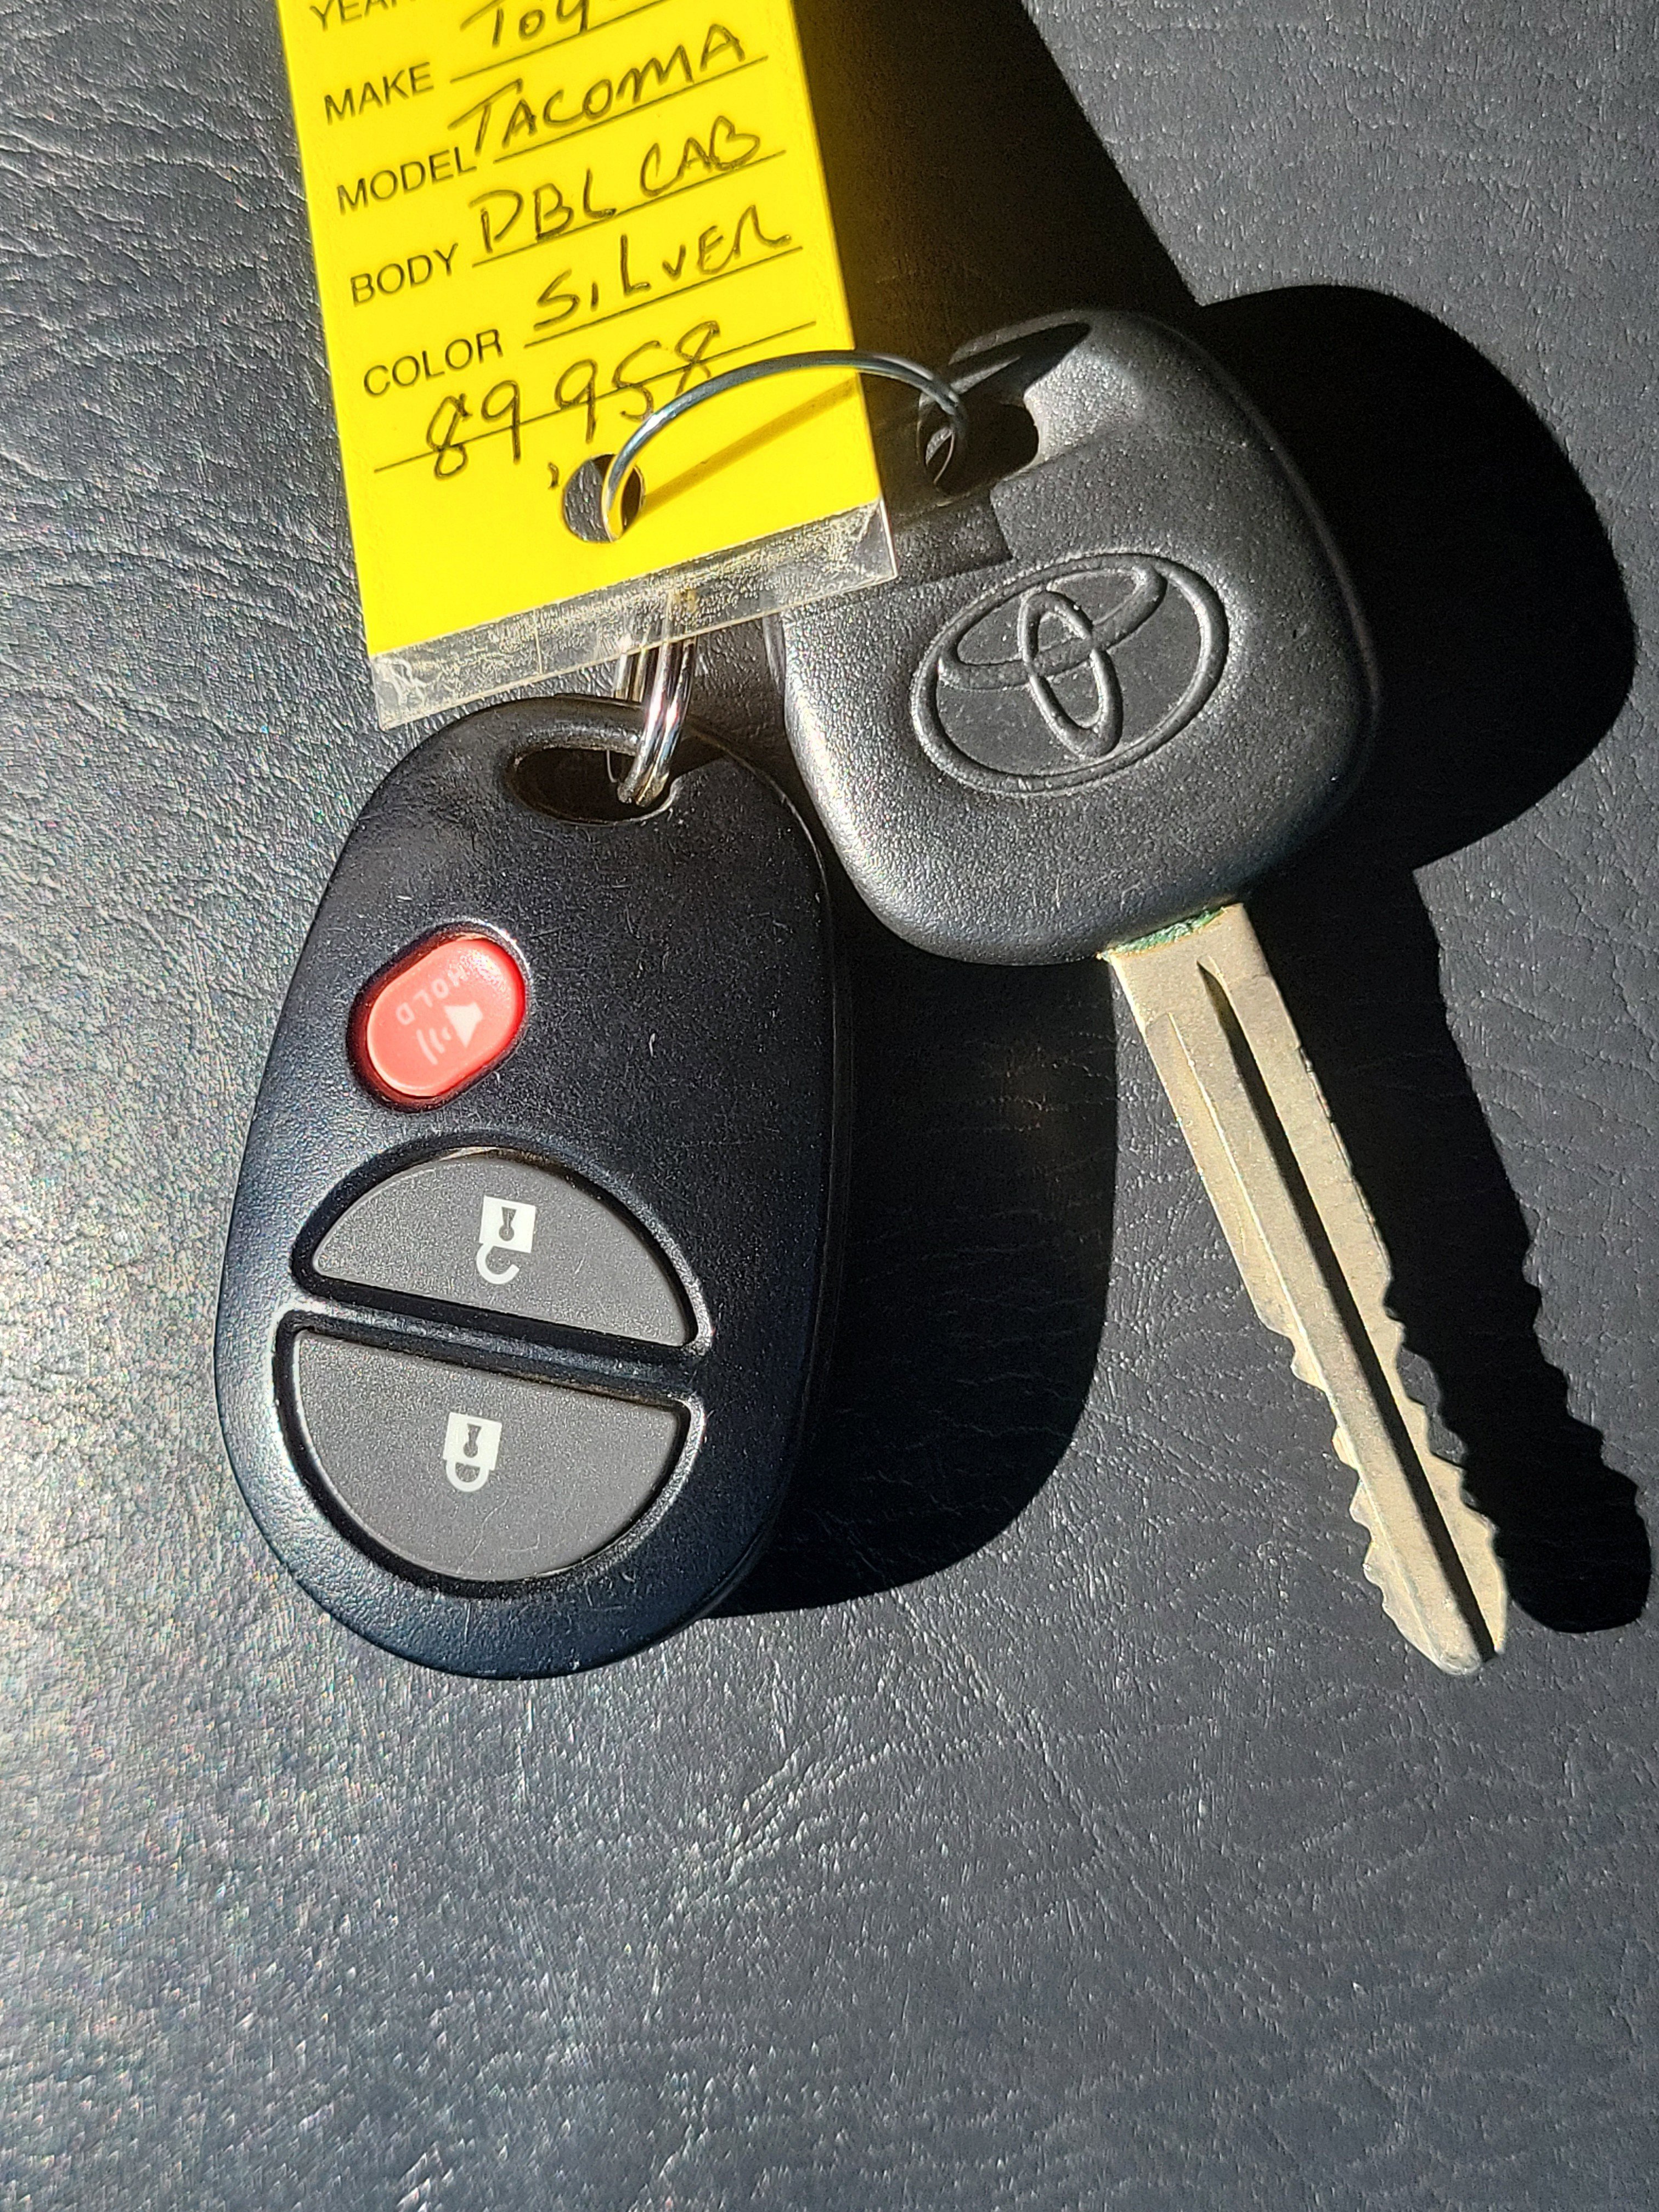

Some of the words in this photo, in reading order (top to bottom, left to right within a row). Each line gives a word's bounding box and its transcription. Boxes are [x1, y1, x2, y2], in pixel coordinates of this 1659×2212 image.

[309, 0, 397, 32] YEA
[323, 61, 434, 125] MAKE
[447, 23, 747, 157] TACOMA
[336, 146, 476, 215] MODEL
[468, 168, 617, 254] DBL
[639, 116, 761, 198] CAB
[349, 242, 459, 306] BODY
[363, 328, 502, 397] COLOR
[396, 964, 467, 1024] HOLD
